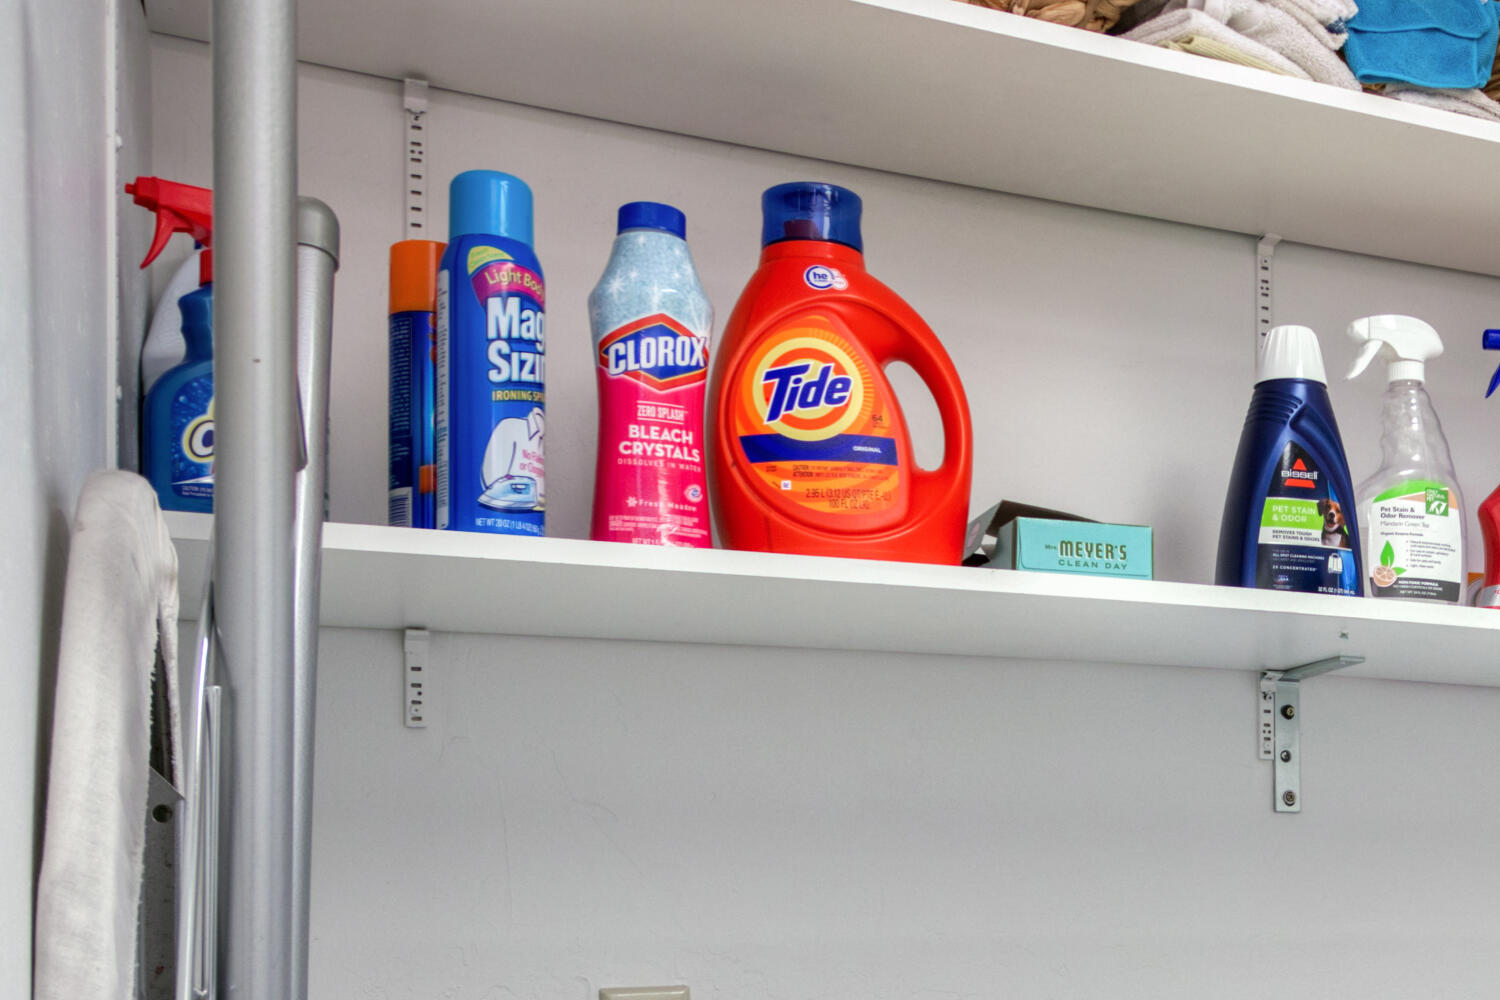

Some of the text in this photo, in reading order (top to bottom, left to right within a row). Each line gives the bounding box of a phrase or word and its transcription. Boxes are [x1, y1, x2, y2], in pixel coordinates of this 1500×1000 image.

[484, 270, 523, 286] Light
[608, 335, 706, 376] CLOROX
[492, 390, 532, 401] IRONING
[762, 361, 853, 425] Tide
[637, 404, 685, 421] ZERO SPLASH
[628, 424, 693, 445] BLEACH
[618, 441, 701, 463] CRYSTALS
[1272, 505, 1316, 515] PET STAIN
[1272, 514, 1308, 523] & ODOR
[1059, 540, 1128, 561] MEYER'S
[1058, 559, 1128, 570] CLEAN DAY
